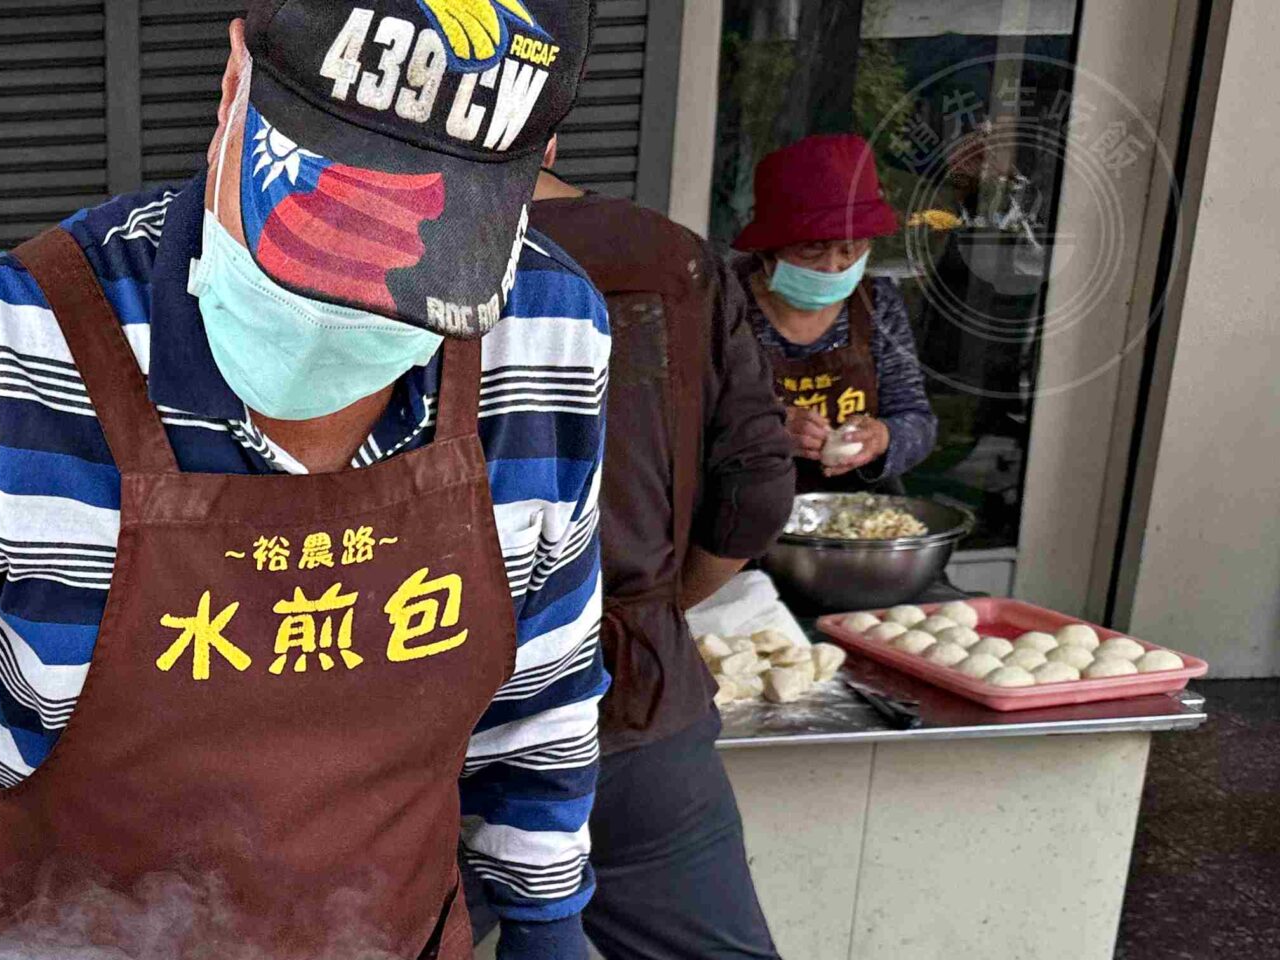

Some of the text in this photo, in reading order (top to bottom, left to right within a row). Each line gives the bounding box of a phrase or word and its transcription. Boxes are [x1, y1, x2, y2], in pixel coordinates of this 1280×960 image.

[320, 8, 549, 152] 439 CW
[510, 34, 560, 67] ROCAF
[426, 296, 474, 336] ROC
[155, 567, 469, 681] 水煎包
